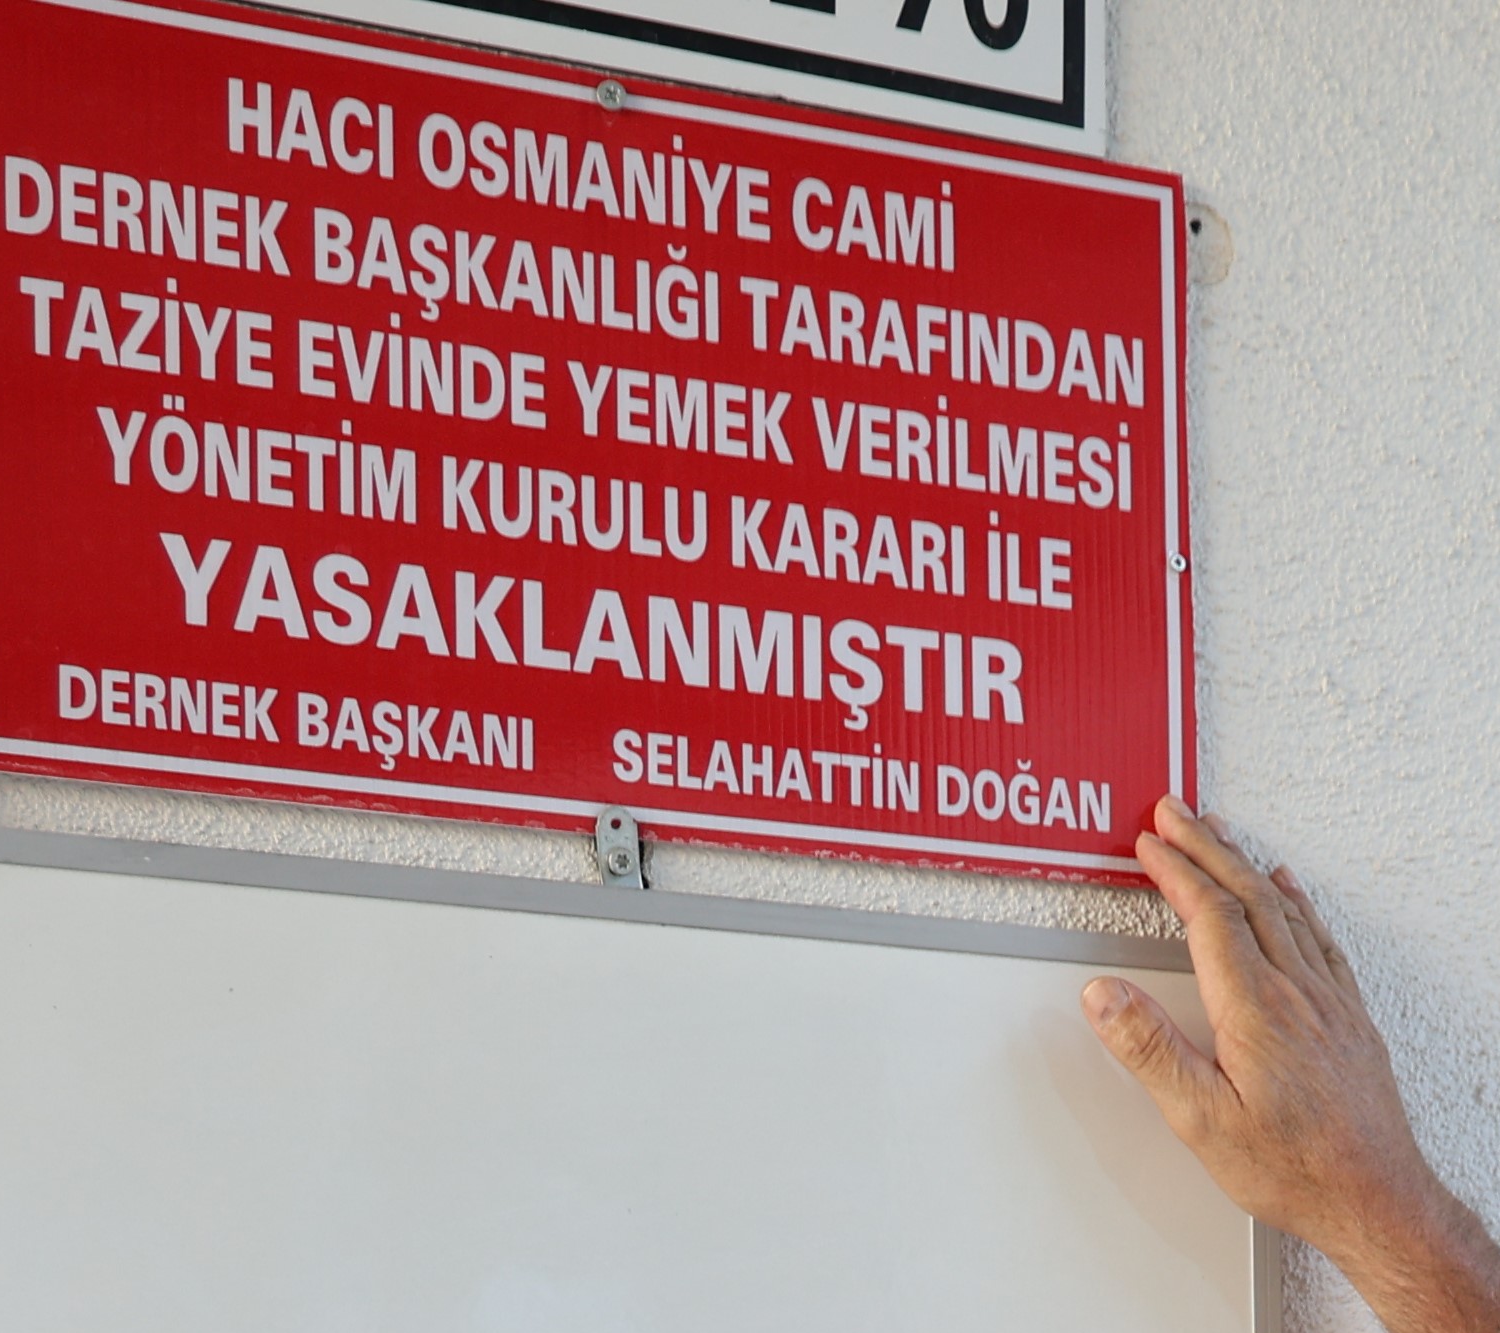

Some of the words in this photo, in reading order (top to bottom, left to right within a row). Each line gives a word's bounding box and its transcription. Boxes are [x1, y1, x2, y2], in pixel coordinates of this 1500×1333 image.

[228, 77, 394, 179] HACI
[418, 113, 771, 242] OSMANİYE
[792, 177, 955, 272] CAMİ
[4, 155, 291, 276] DERNEK
[314, 207, 720, 343] BAŞKANLIĞI
[739, 276, 1144, 408] TARAFINDAN
[19, 276, 274, 389] TAZİYE
[298, 312, 547, 429] EVİNDE
[567, 360, 794, 464] YEMEK
[812, 395, 1132, 512] VERİLMESİ
[96, 394, 417, 524] YÖNETİM
[442, 455, 708, 562] KURULU
[731, 496, 965, 596] KARARI
[987, 510, 1073, 610] İLE
[159, 532, 1024, 731] YASAKLANMIŞTIR
[58, 664, 280, 743] DERNEK
[297, 692, 534, 771] BAŞKANI
[612, 728, 920, 813] SELAHATTİN
[937, 758, 1111, 833] DOĞAN
